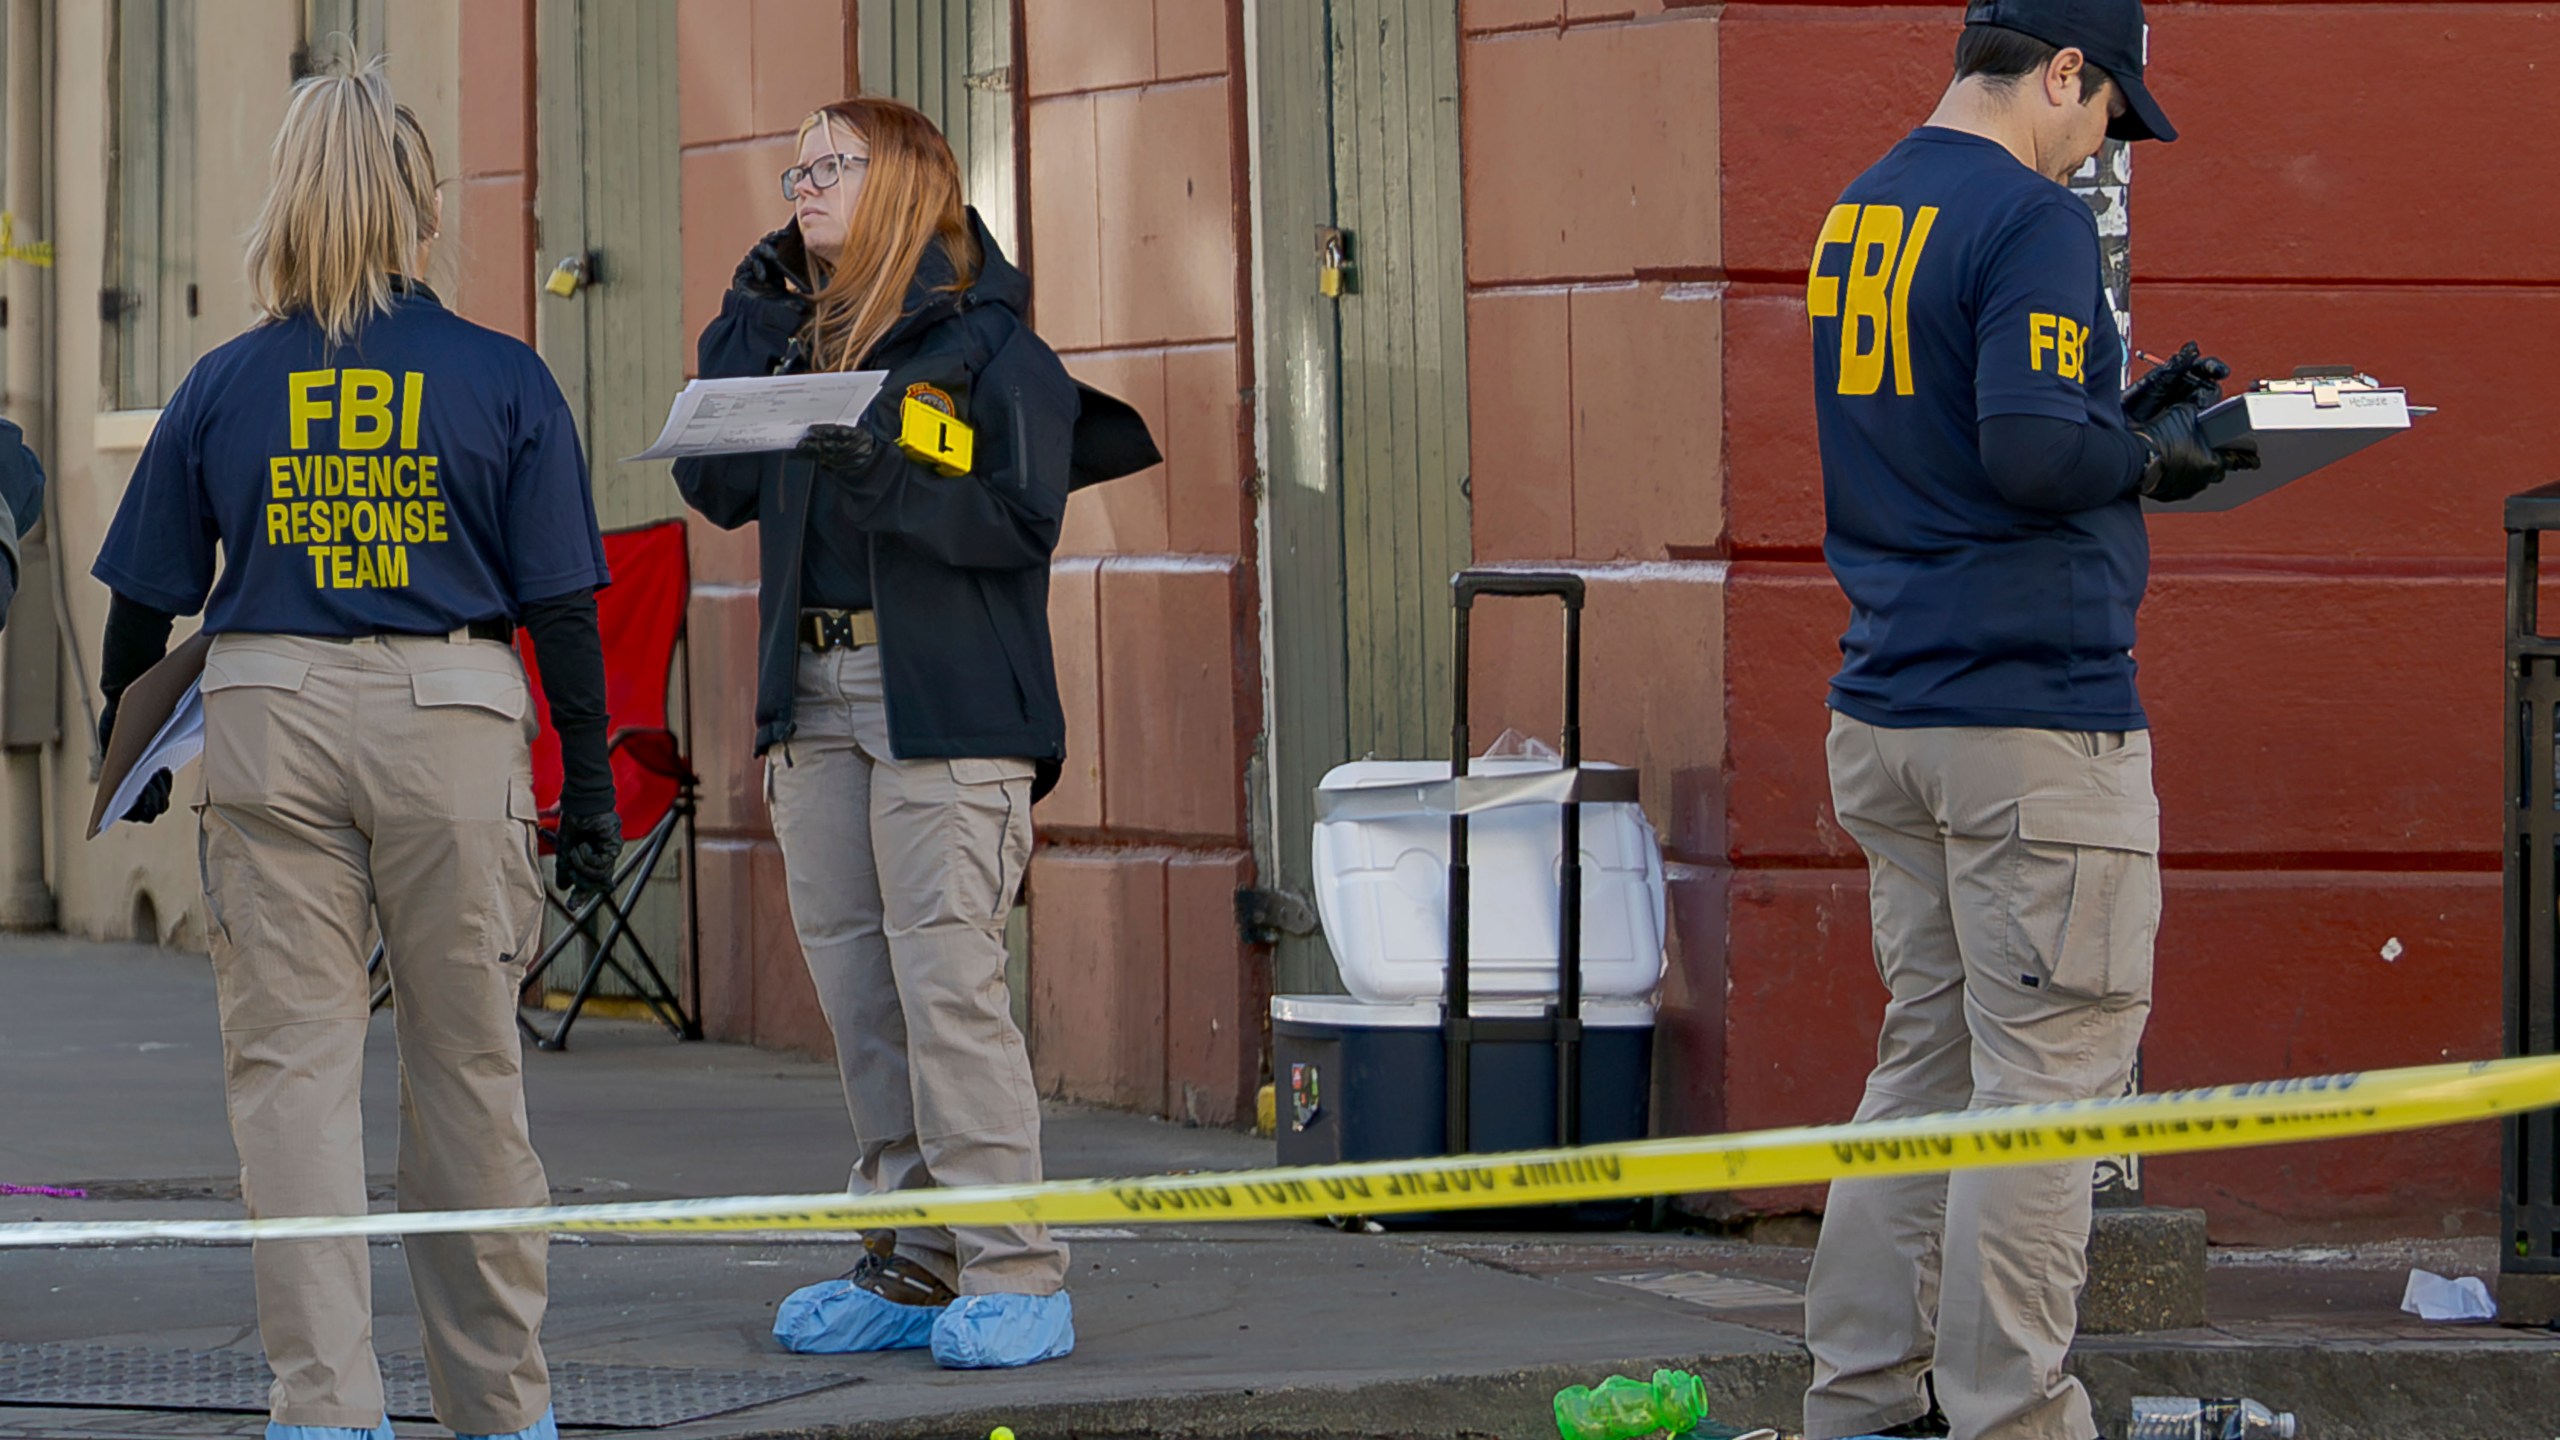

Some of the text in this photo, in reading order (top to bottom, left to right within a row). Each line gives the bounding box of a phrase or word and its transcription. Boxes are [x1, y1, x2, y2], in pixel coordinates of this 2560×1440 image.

[1807, 204, 1938, 395] FBI
[2030, 313, 2089, 384] FBI
[289, 369, 423, 450] FBI
[270, 455, 438, 497] EVIDENCE
[267, 501, 447, 544] RESPONSE
[307, 545, 408, 588] TEAM
